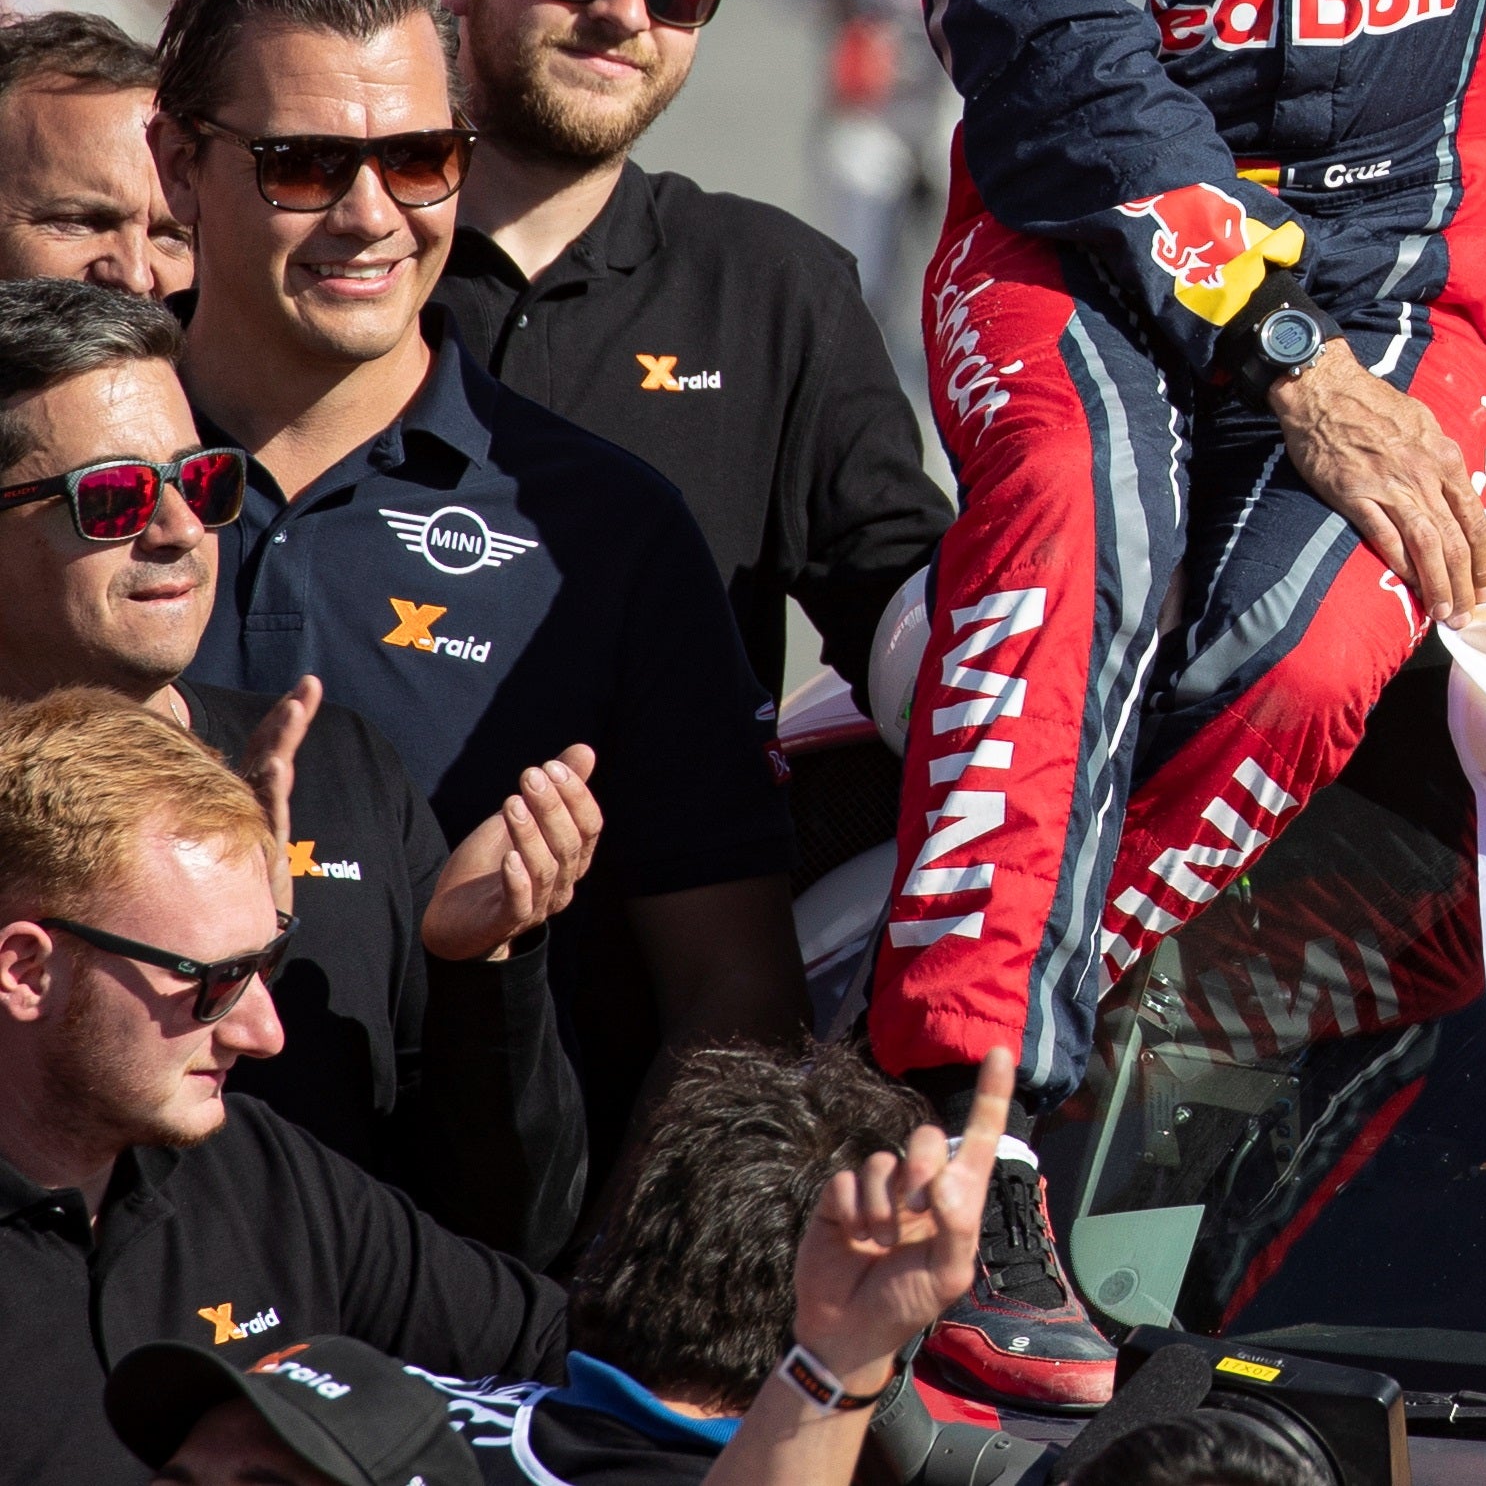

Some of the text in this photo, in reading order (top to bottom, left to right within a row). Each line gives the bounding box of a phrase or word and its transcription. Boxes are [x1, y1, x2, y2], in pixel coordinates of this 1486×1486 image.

[1286, 158, 1393, 190] L. Cruz
[635, 353, 722, 392] X-raid
[429, 527, 483, 555] MINI
[381, 597, 492, 663] X-raid
[888, 586, 1048, 949] MINI
[196, 1302, 281, 1345] X-raid
